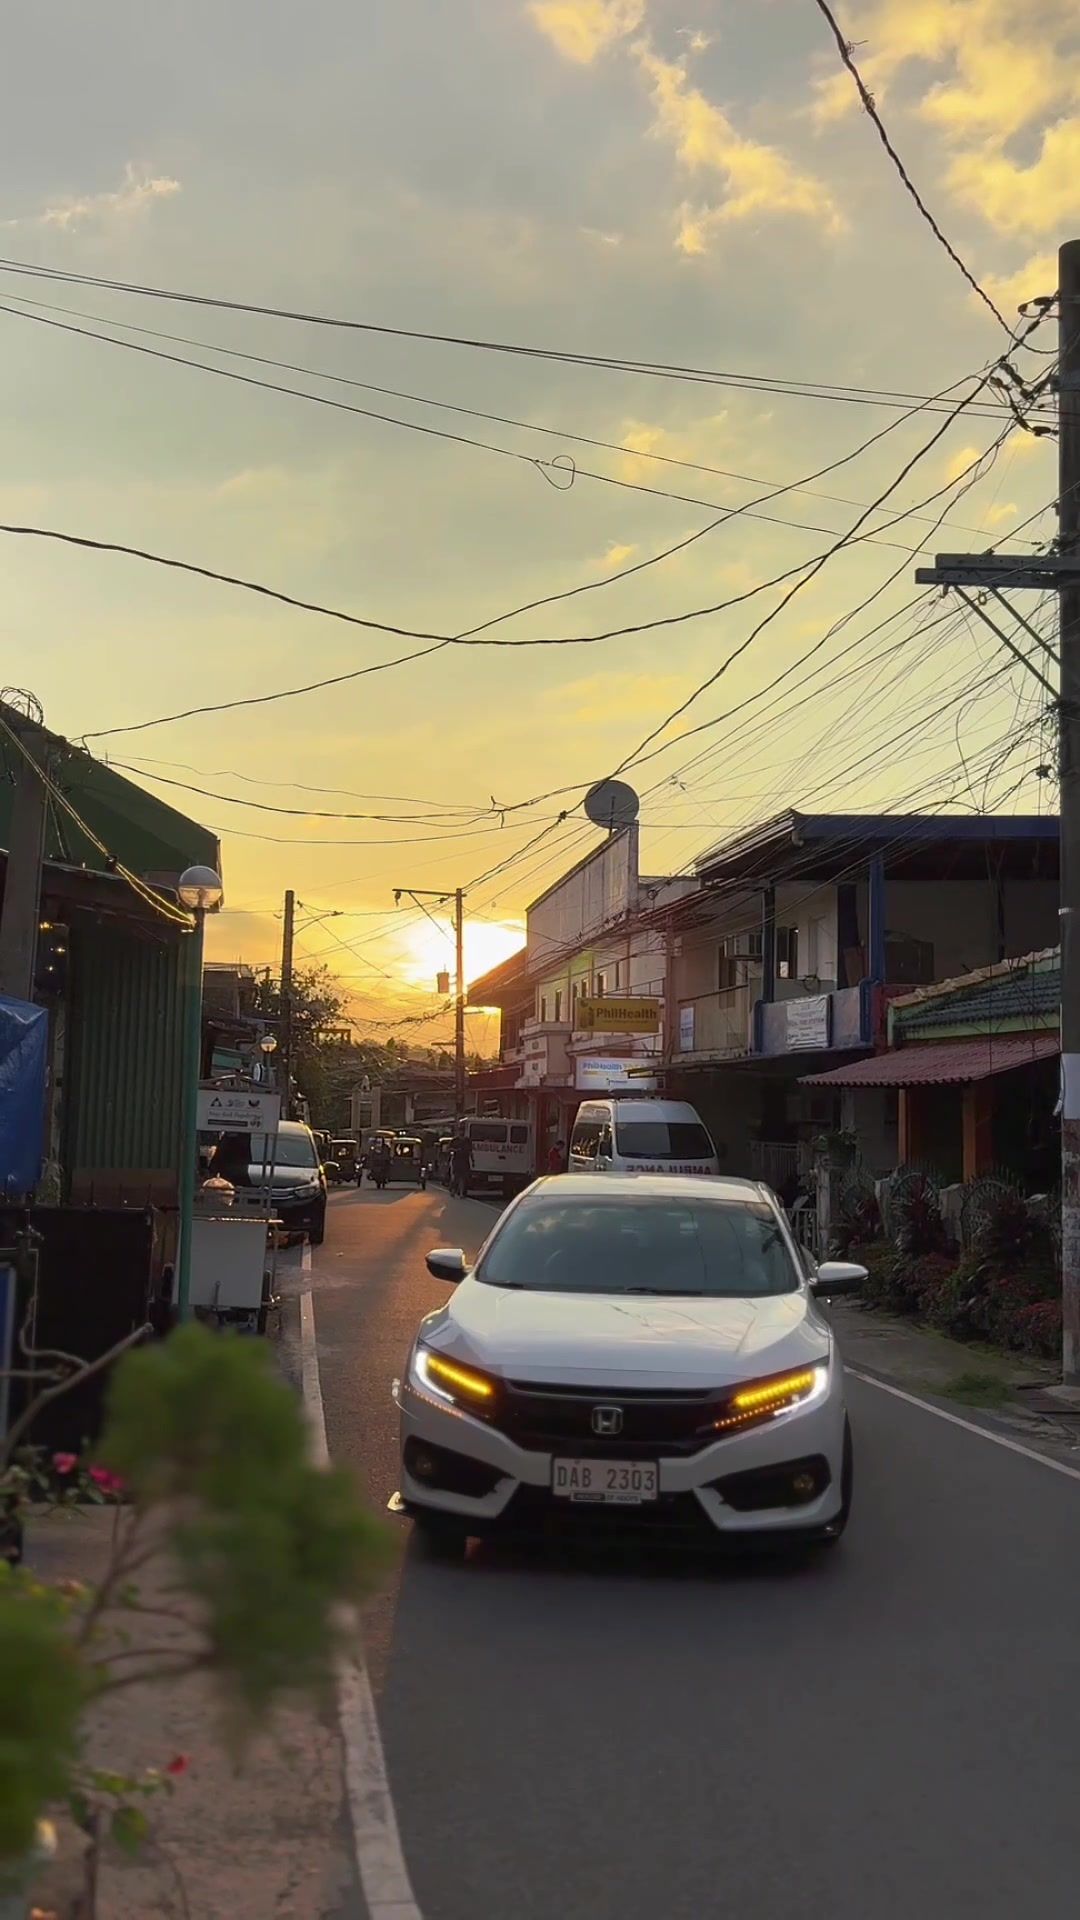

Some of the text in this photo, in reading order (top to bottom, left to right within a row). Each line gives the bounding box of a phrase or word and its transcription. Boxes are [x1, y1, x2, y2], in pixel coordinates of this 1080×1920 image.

[596, 1007, 657, 1019] PhilHealth
[557, 1466, 655, 1491] DAB 2303
